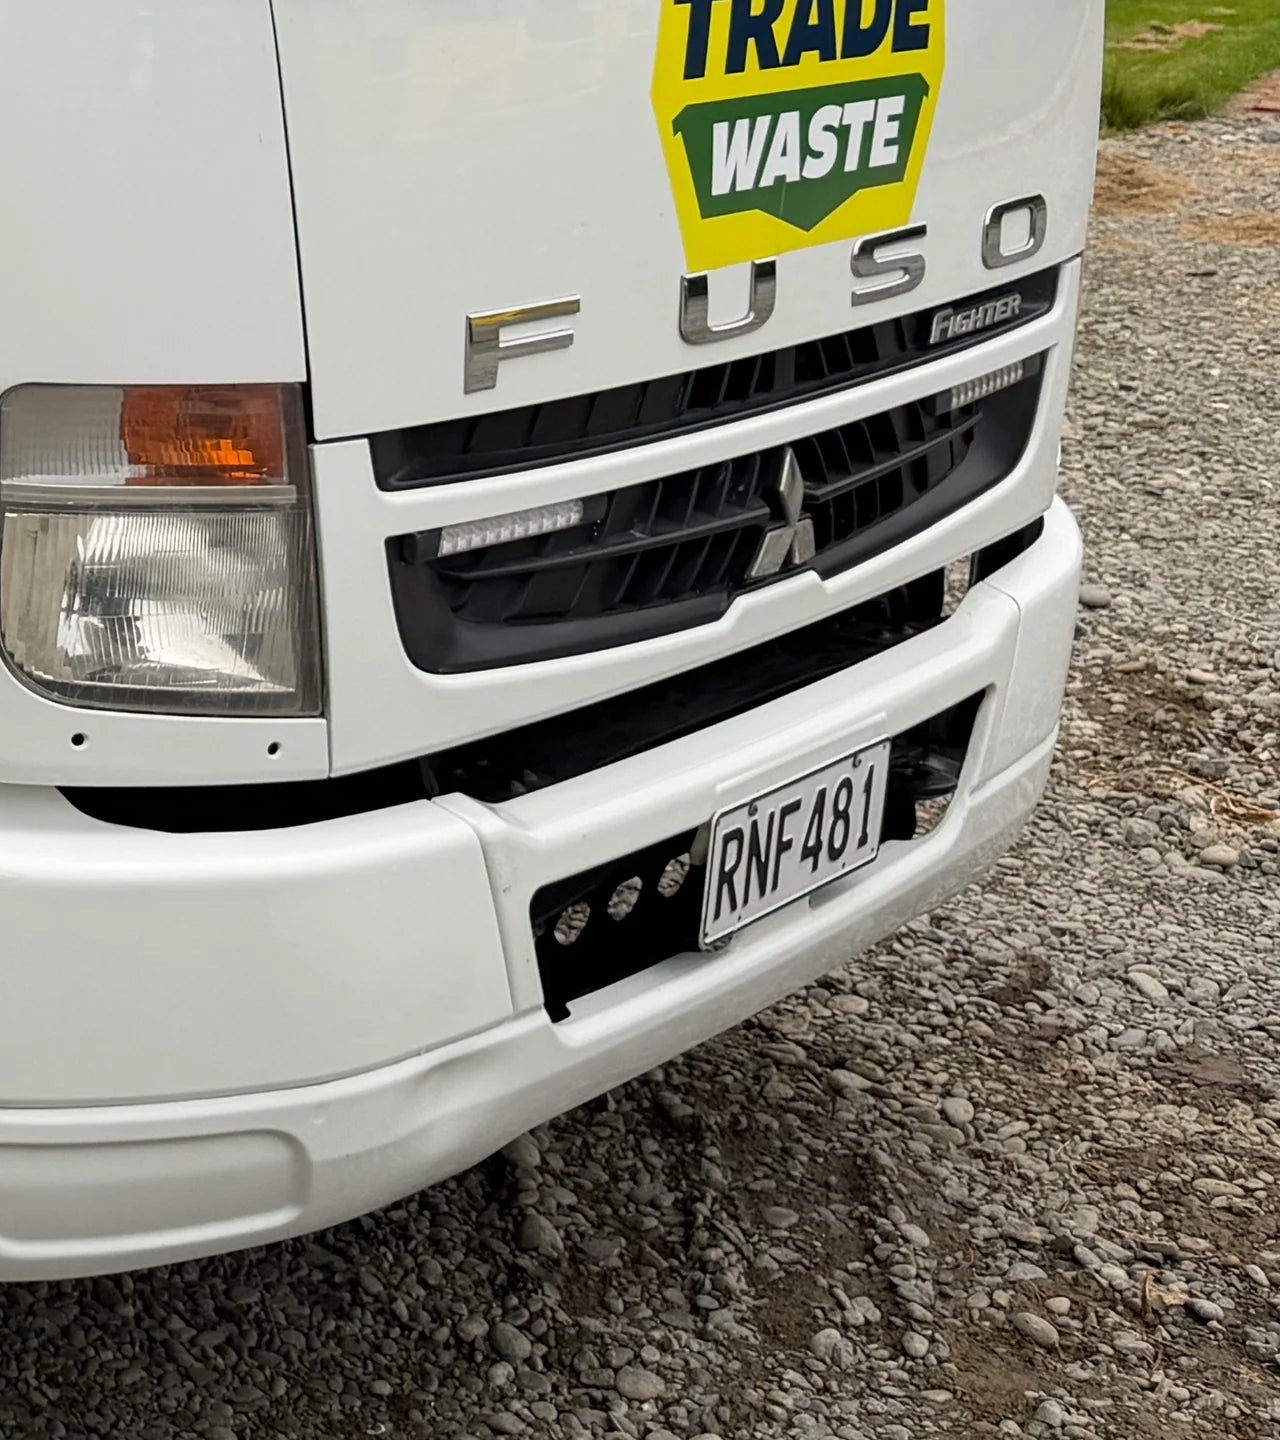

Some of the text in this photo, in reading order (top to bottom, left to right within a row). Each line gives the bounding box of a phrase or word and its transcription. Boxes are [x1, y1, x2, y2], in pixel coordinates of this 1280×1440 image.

[711, 94, 906, 196] WASTE
[463, 193, 1047, 395] FUSO
[712, 763, 876, 923] RNF481
